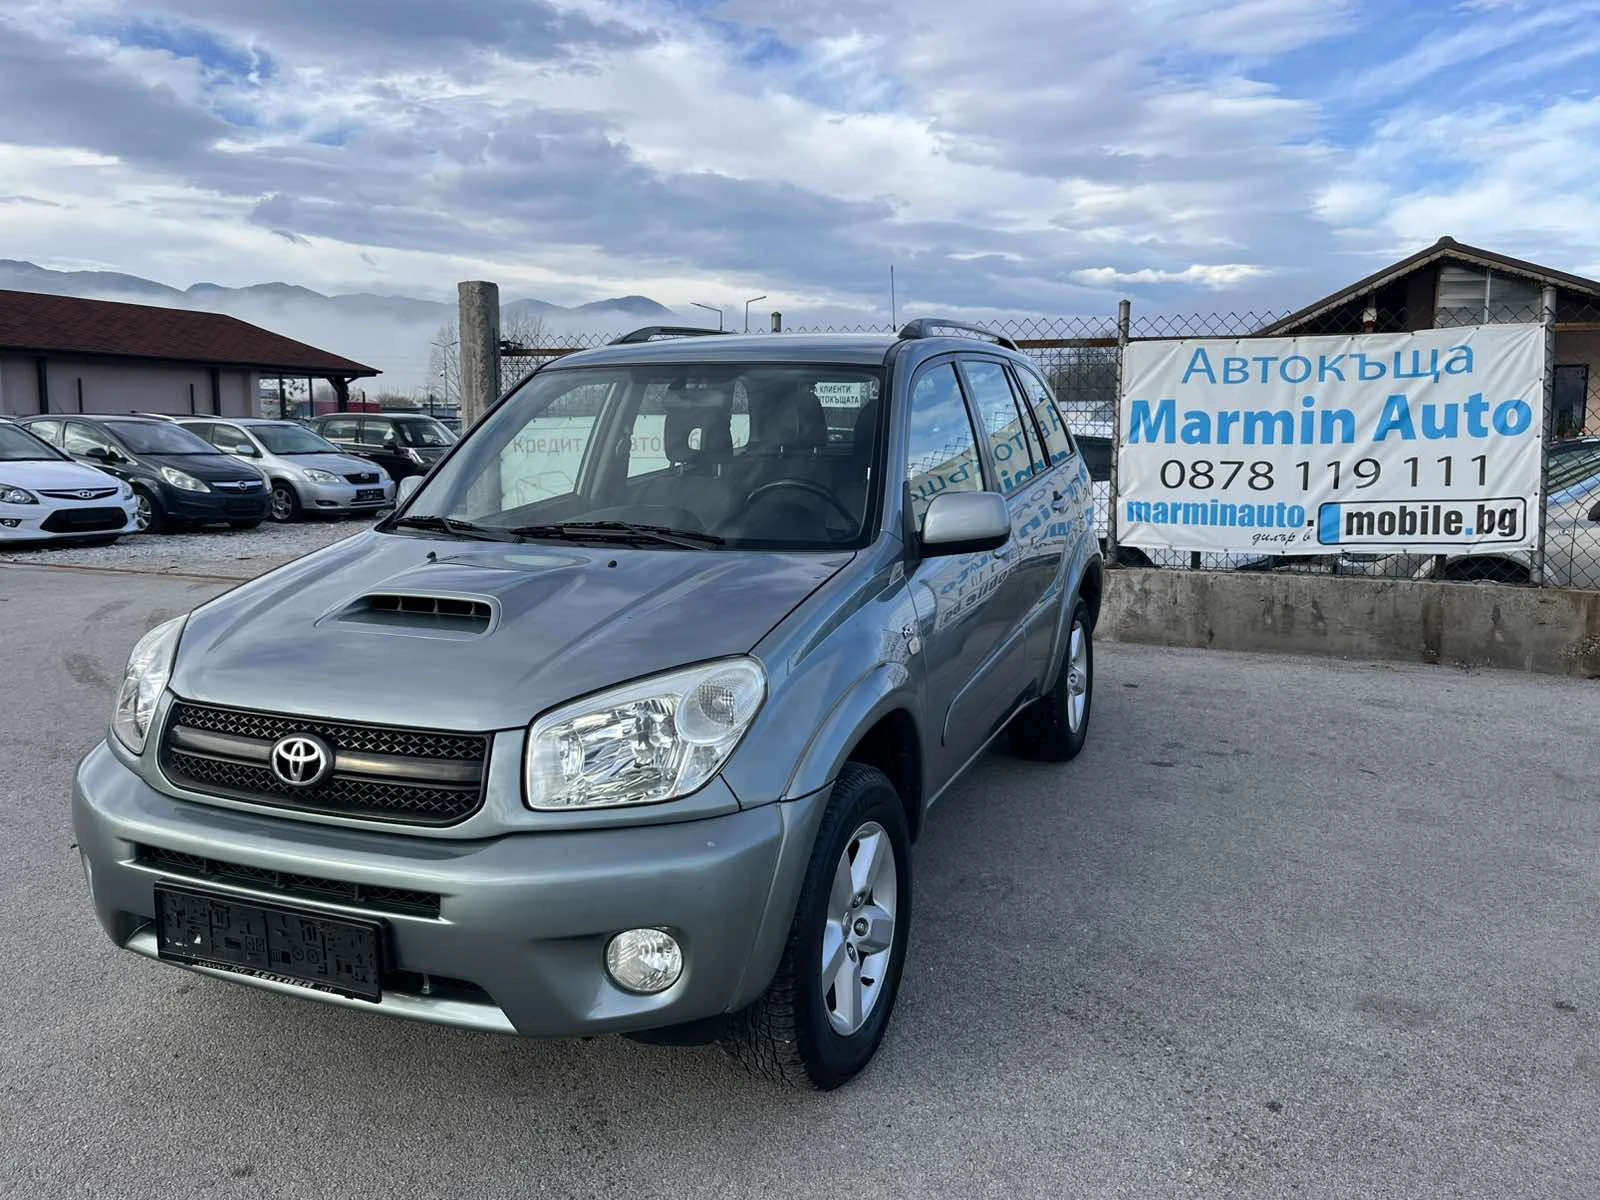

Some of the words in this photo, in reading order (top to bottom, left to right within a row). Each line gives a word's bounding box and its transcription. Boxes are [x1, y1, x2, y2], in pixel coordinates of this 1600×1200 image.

[1181, 344, 1474, 384] Автокъща
[820, 385, 851, 394] КЛИЕНТИ
[820, 395, 859, 404] ТОКЪЩАТА
[1128, 396, 1355, 445] Marmin
[1372, 392, 1532, 442] Auto
[1160, 459, 1274, 491] 0878
[1295, 458, 1382, 490] 119
[1403, 455, 1487, 488] 111
[1345, 504, 1517, 537] mobile.bg
